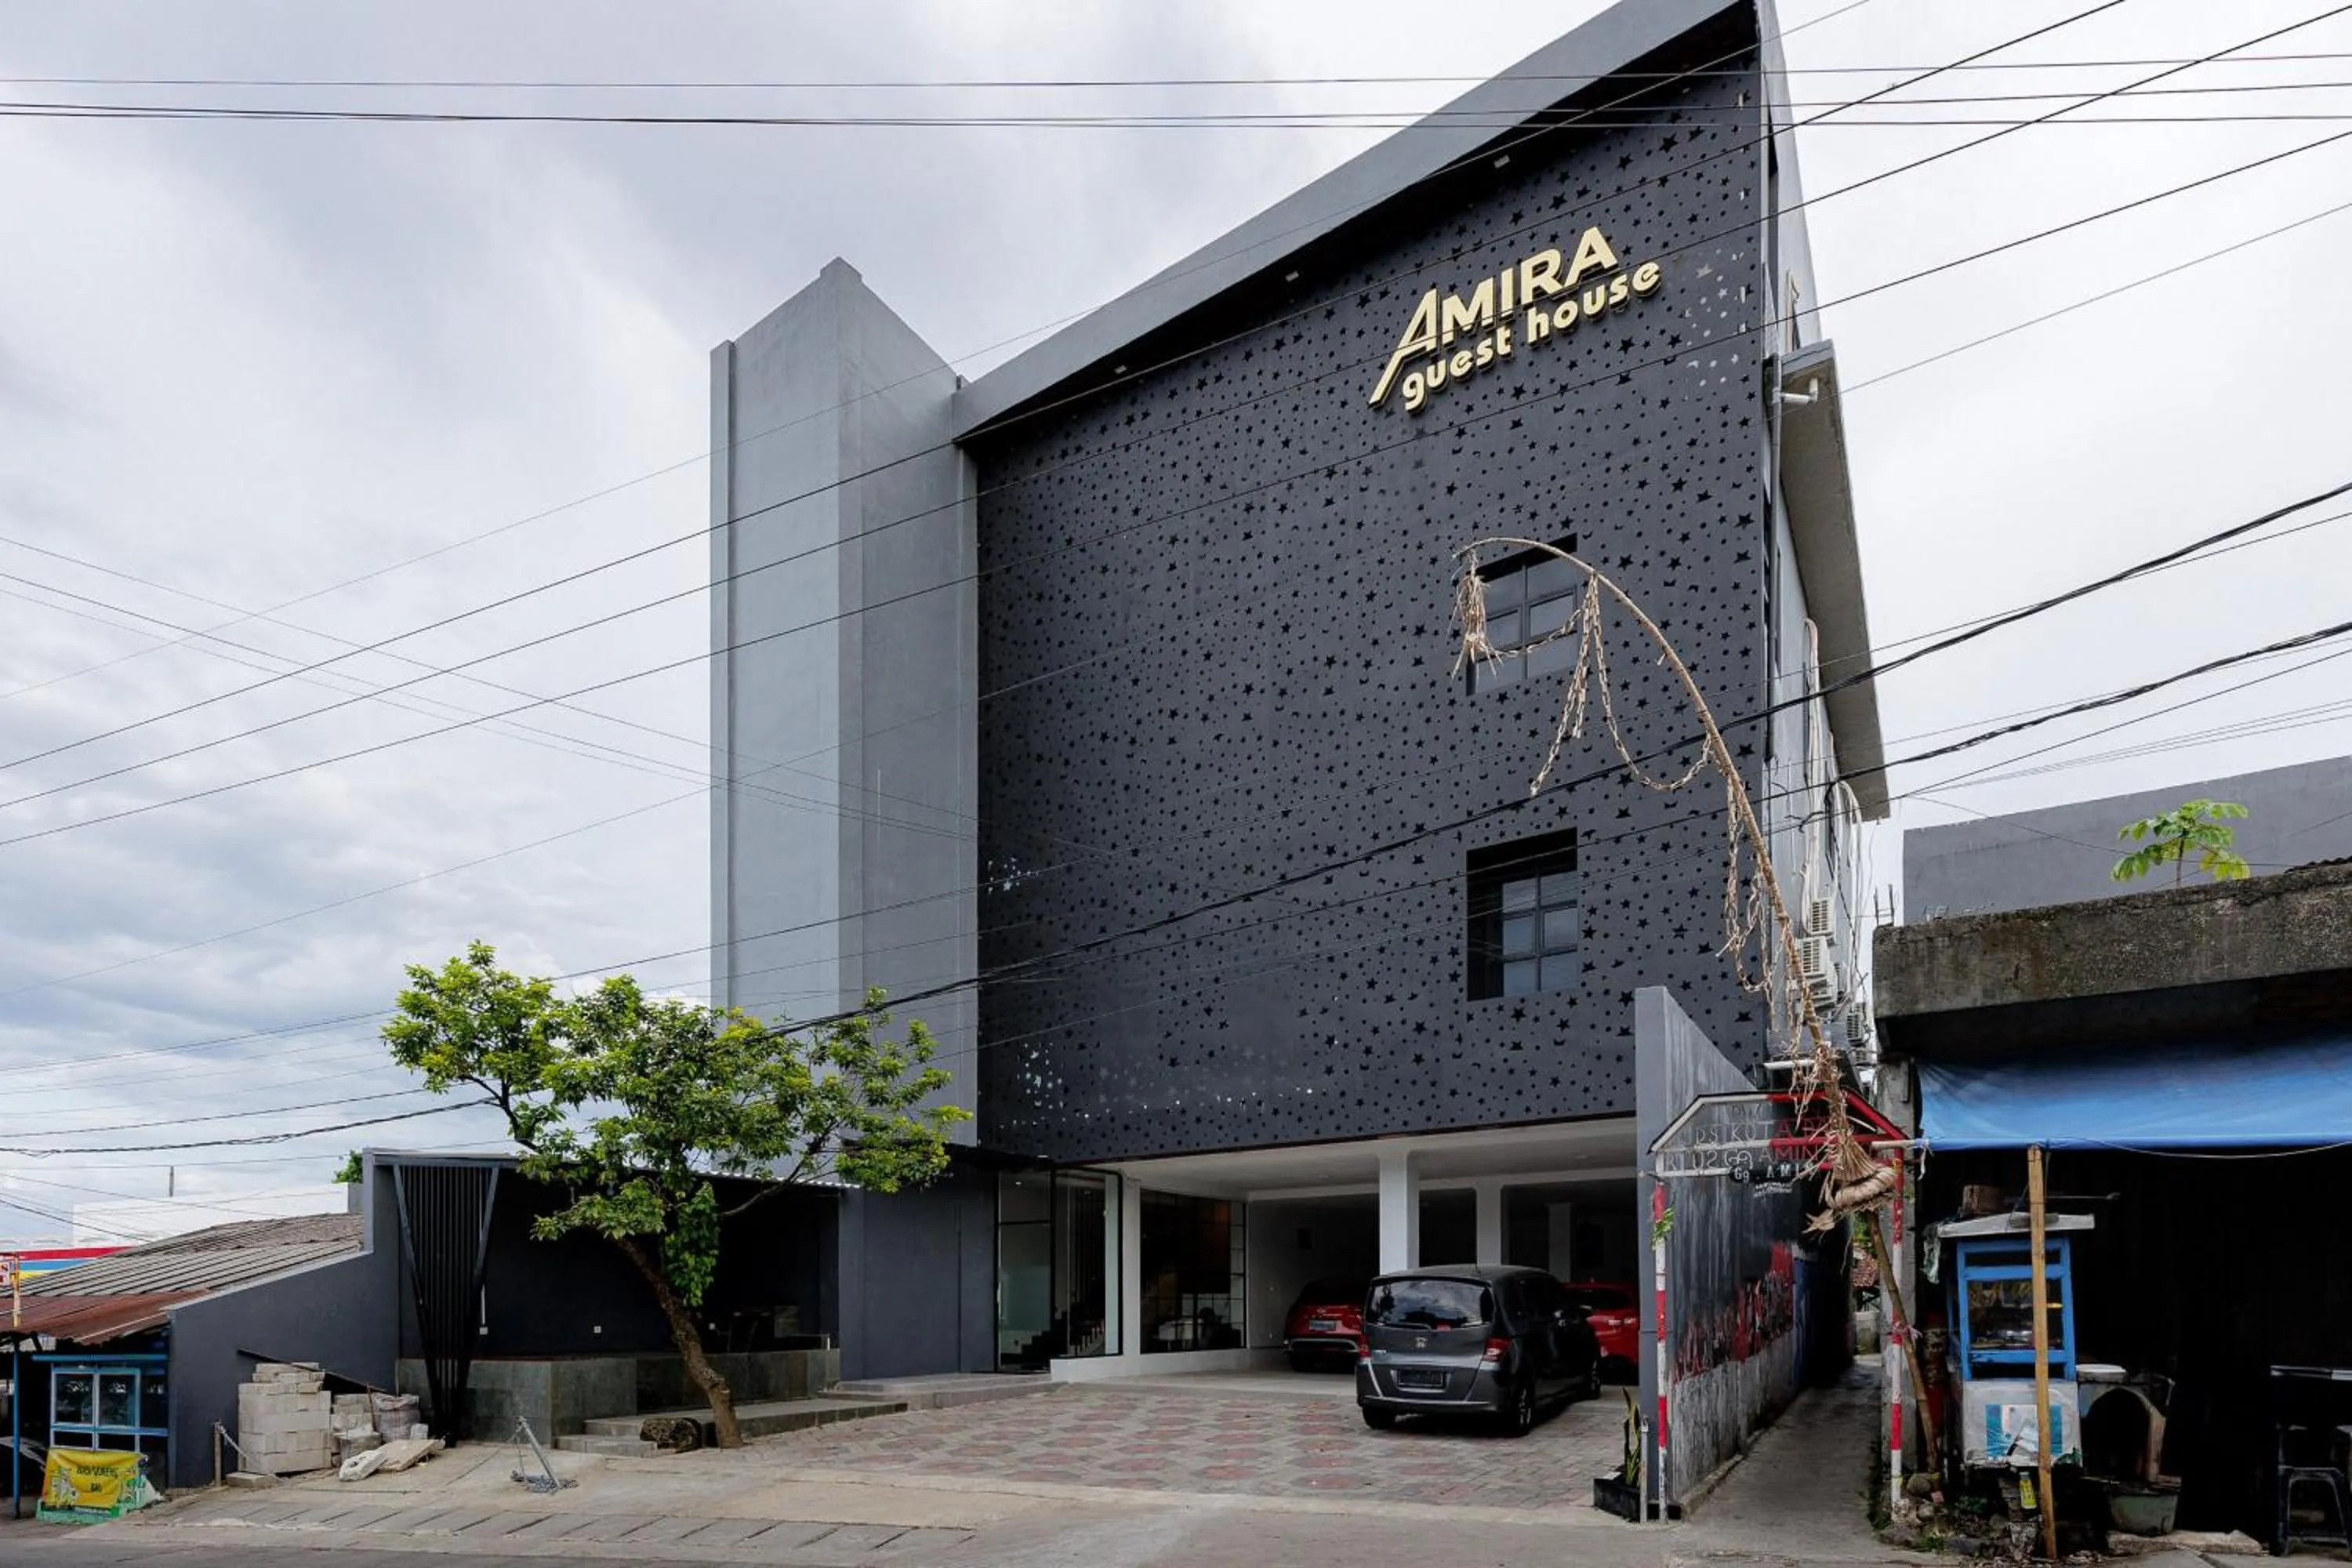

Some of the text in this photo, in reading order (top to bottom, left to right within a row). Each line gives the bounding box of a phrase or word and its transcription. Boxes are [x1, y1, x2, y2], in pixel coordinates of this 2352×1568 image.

[1369, 226, 1621, 406] AMIRA
[1401, 260, 1662, 412] guest house
